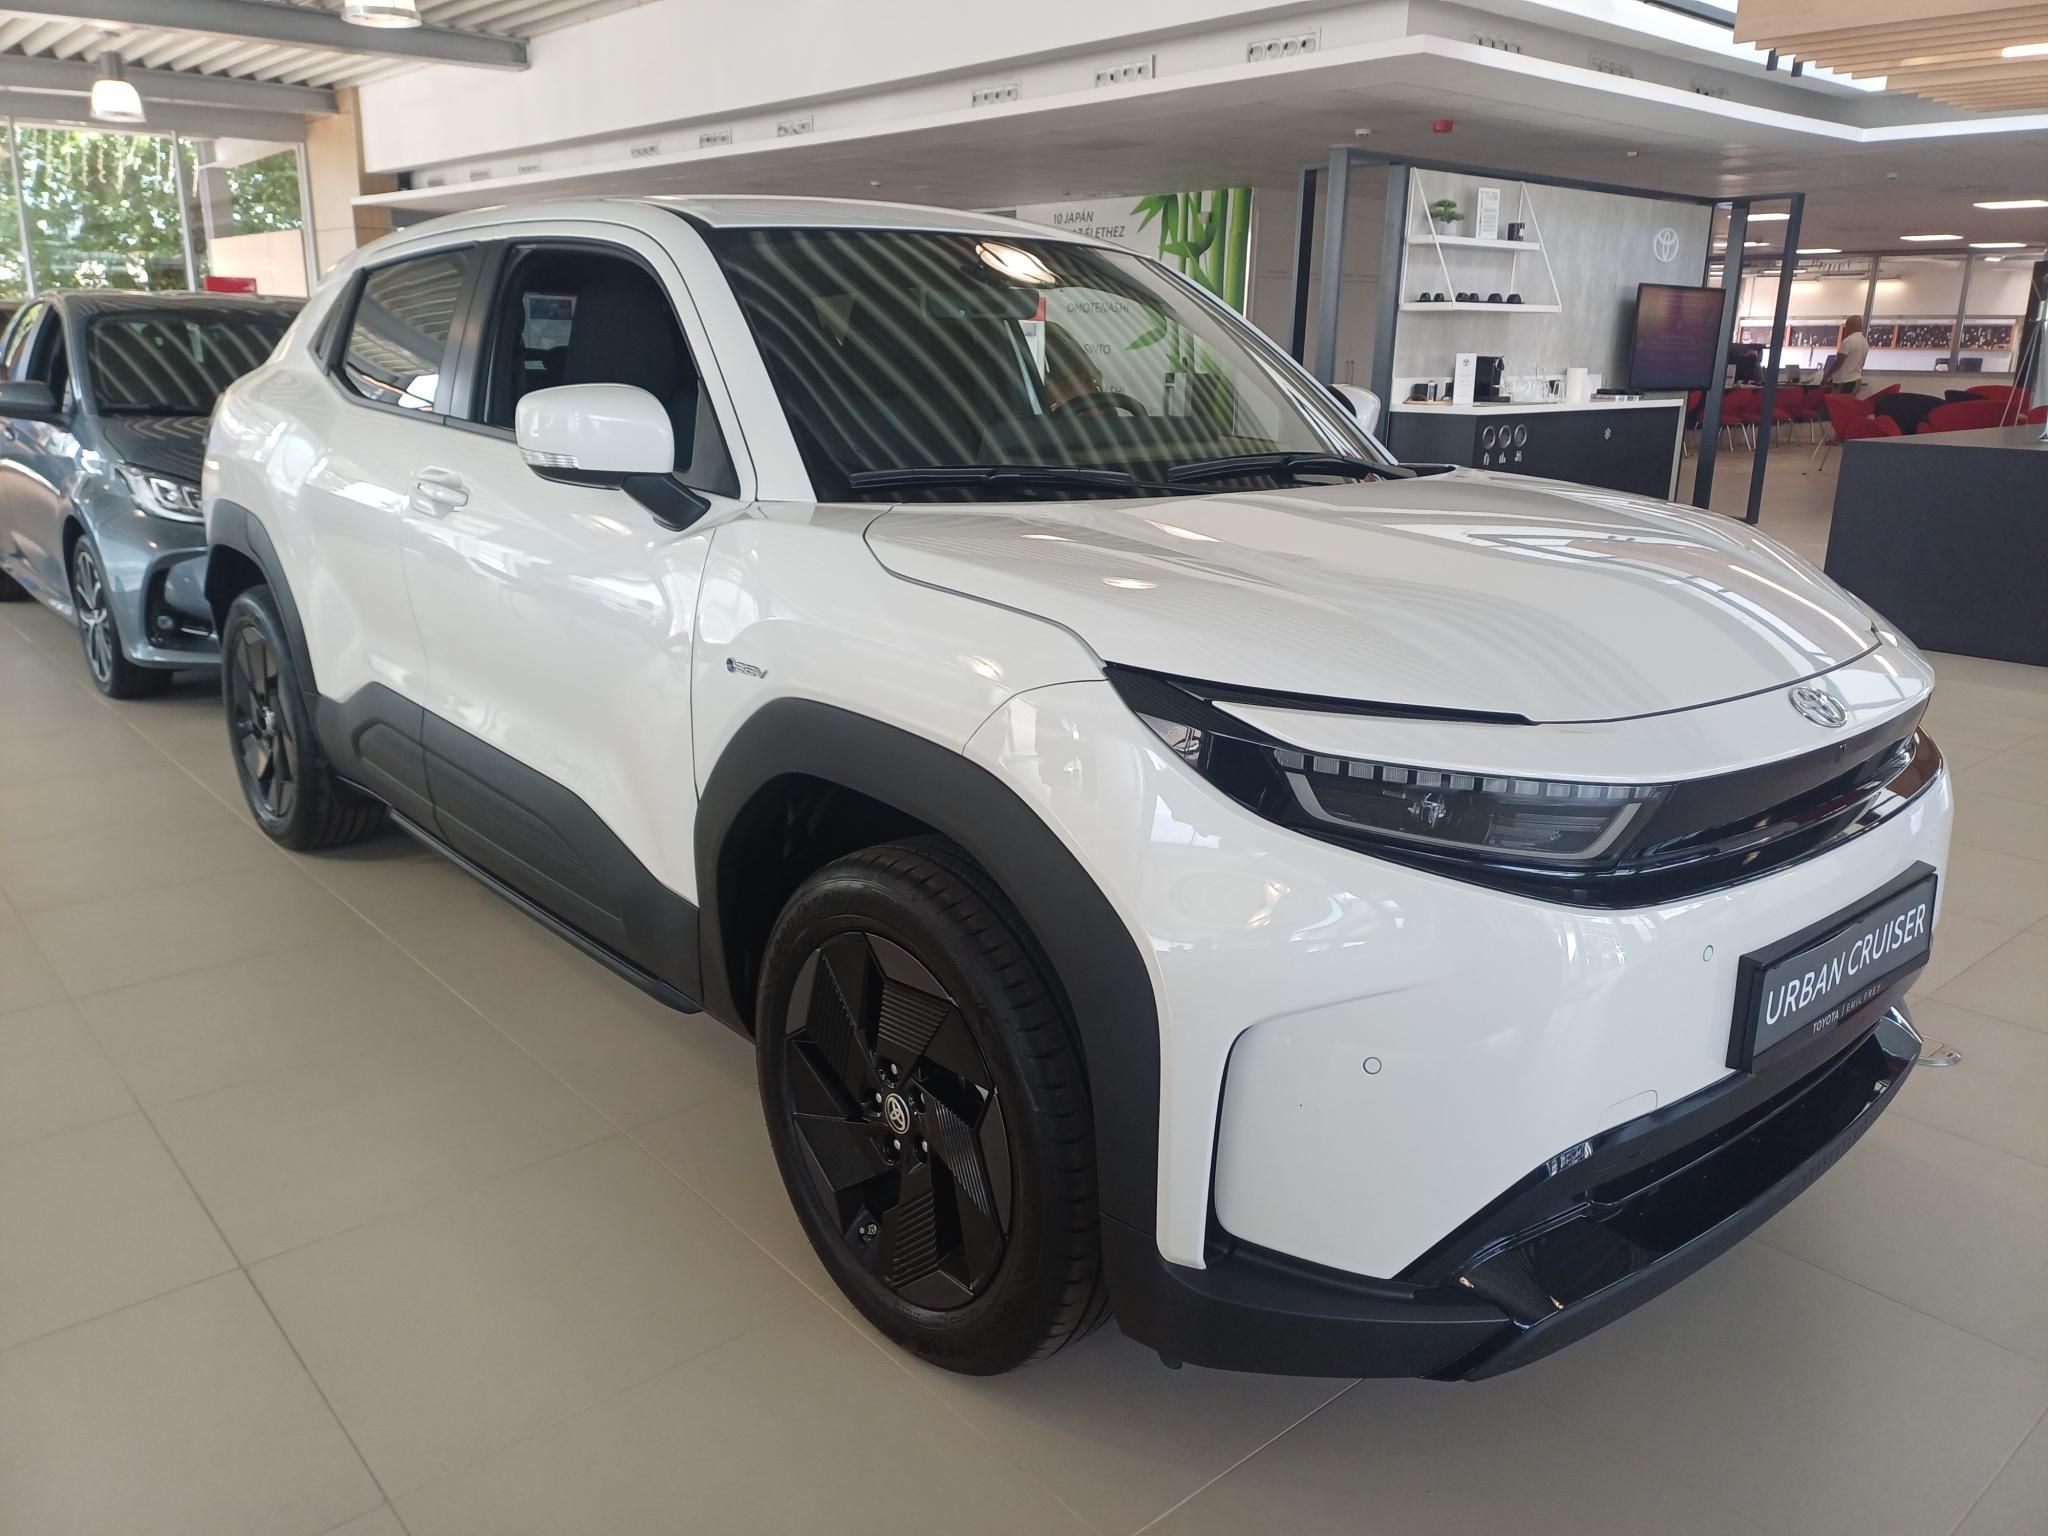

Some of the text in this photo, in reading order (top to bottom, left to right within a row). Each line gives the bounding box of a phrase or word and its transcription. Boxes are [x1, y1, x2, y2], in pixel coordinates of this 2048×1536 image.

[1053, 210, 1094, 225] 10 JAPÁN
[1067, 302, 1129, 313] OMOTENASHI
[1084, 344, 1111, 354] SINTO
[1765, 903, 1927, 1025] URBAN CRUISER
[1812, 1009, 1839, 1034] TOYOTA
[1846, 997, 1862, 1013] EMIL
[1863, 984, 1881, 1001] FREY
